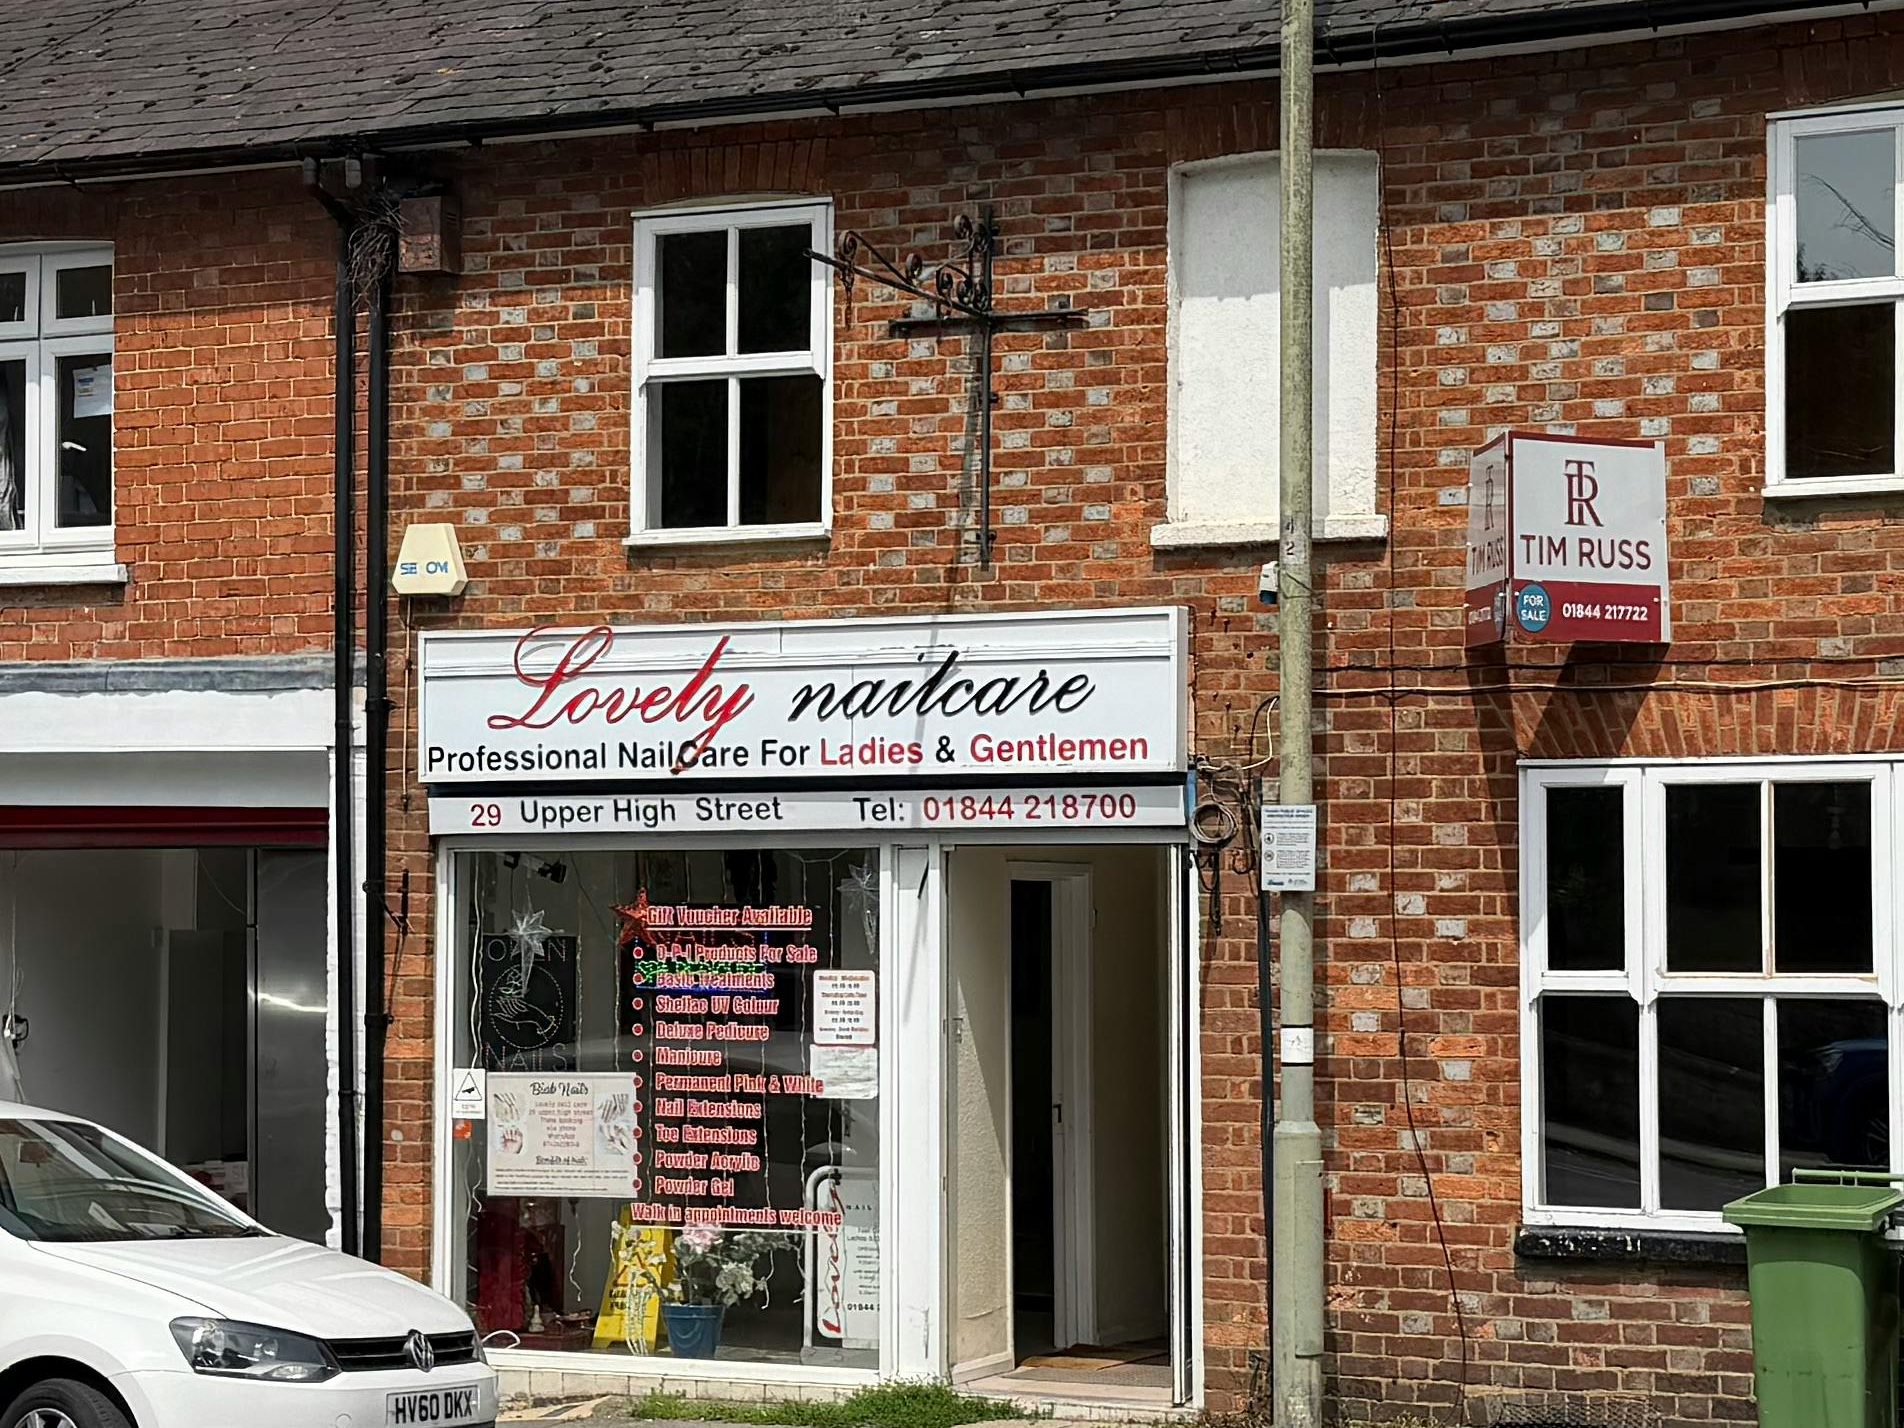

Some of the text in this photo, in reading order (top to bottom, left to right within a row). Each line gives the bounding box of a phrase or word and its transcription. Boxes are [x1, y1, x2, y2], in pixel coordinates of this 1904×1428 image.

[1520, 534, 1651, 571] TIM RUSS
[1523, 594, 1544, 608] FOR
[1521, 608, 1547, 622] SALE
[1562, 602, 1648, 622] 01844 217722
[487, 625, 1096, 775] Lovely nailcare
[428, 742, 606, 773] Professional
[761, 739, 810, 766] For
[820, 737, 924, 766] Ladies
[936, 735, 956, 763] &
[970, 732, 1148, 763] Gentlemen
[470, 793, 1136, 828] 29 Upper High Street Tel: 01844 218700
[676, 906, 739, 925] Voucher
[742, 906, 813, 926] Available
[695, 944, 757, 963] Products
[760, 945, 783, 963] For
[786, 945, 818, 963] Sale
[656, 995, 780, 1015] Shellac UV Colour
[656, 1021, 770, 1040] Deluxe Pedicure
[656, 1047, 722, 1066] Manicure
[656, 1073, 824, 1094] Permanent Pink & White
[655, 1098, 761, 1118] Nail Extensions
[655, 1124, 757, 1144] Toe Extensions
[655, 1150, 760, 1172] Powder Acrylic
[655, 1176, 734, 1196] Powder Gel
[631, 1203, 842, 1228] Walk in appointments welcome
[395, 1390, 473, 1425] HV60 DKX
